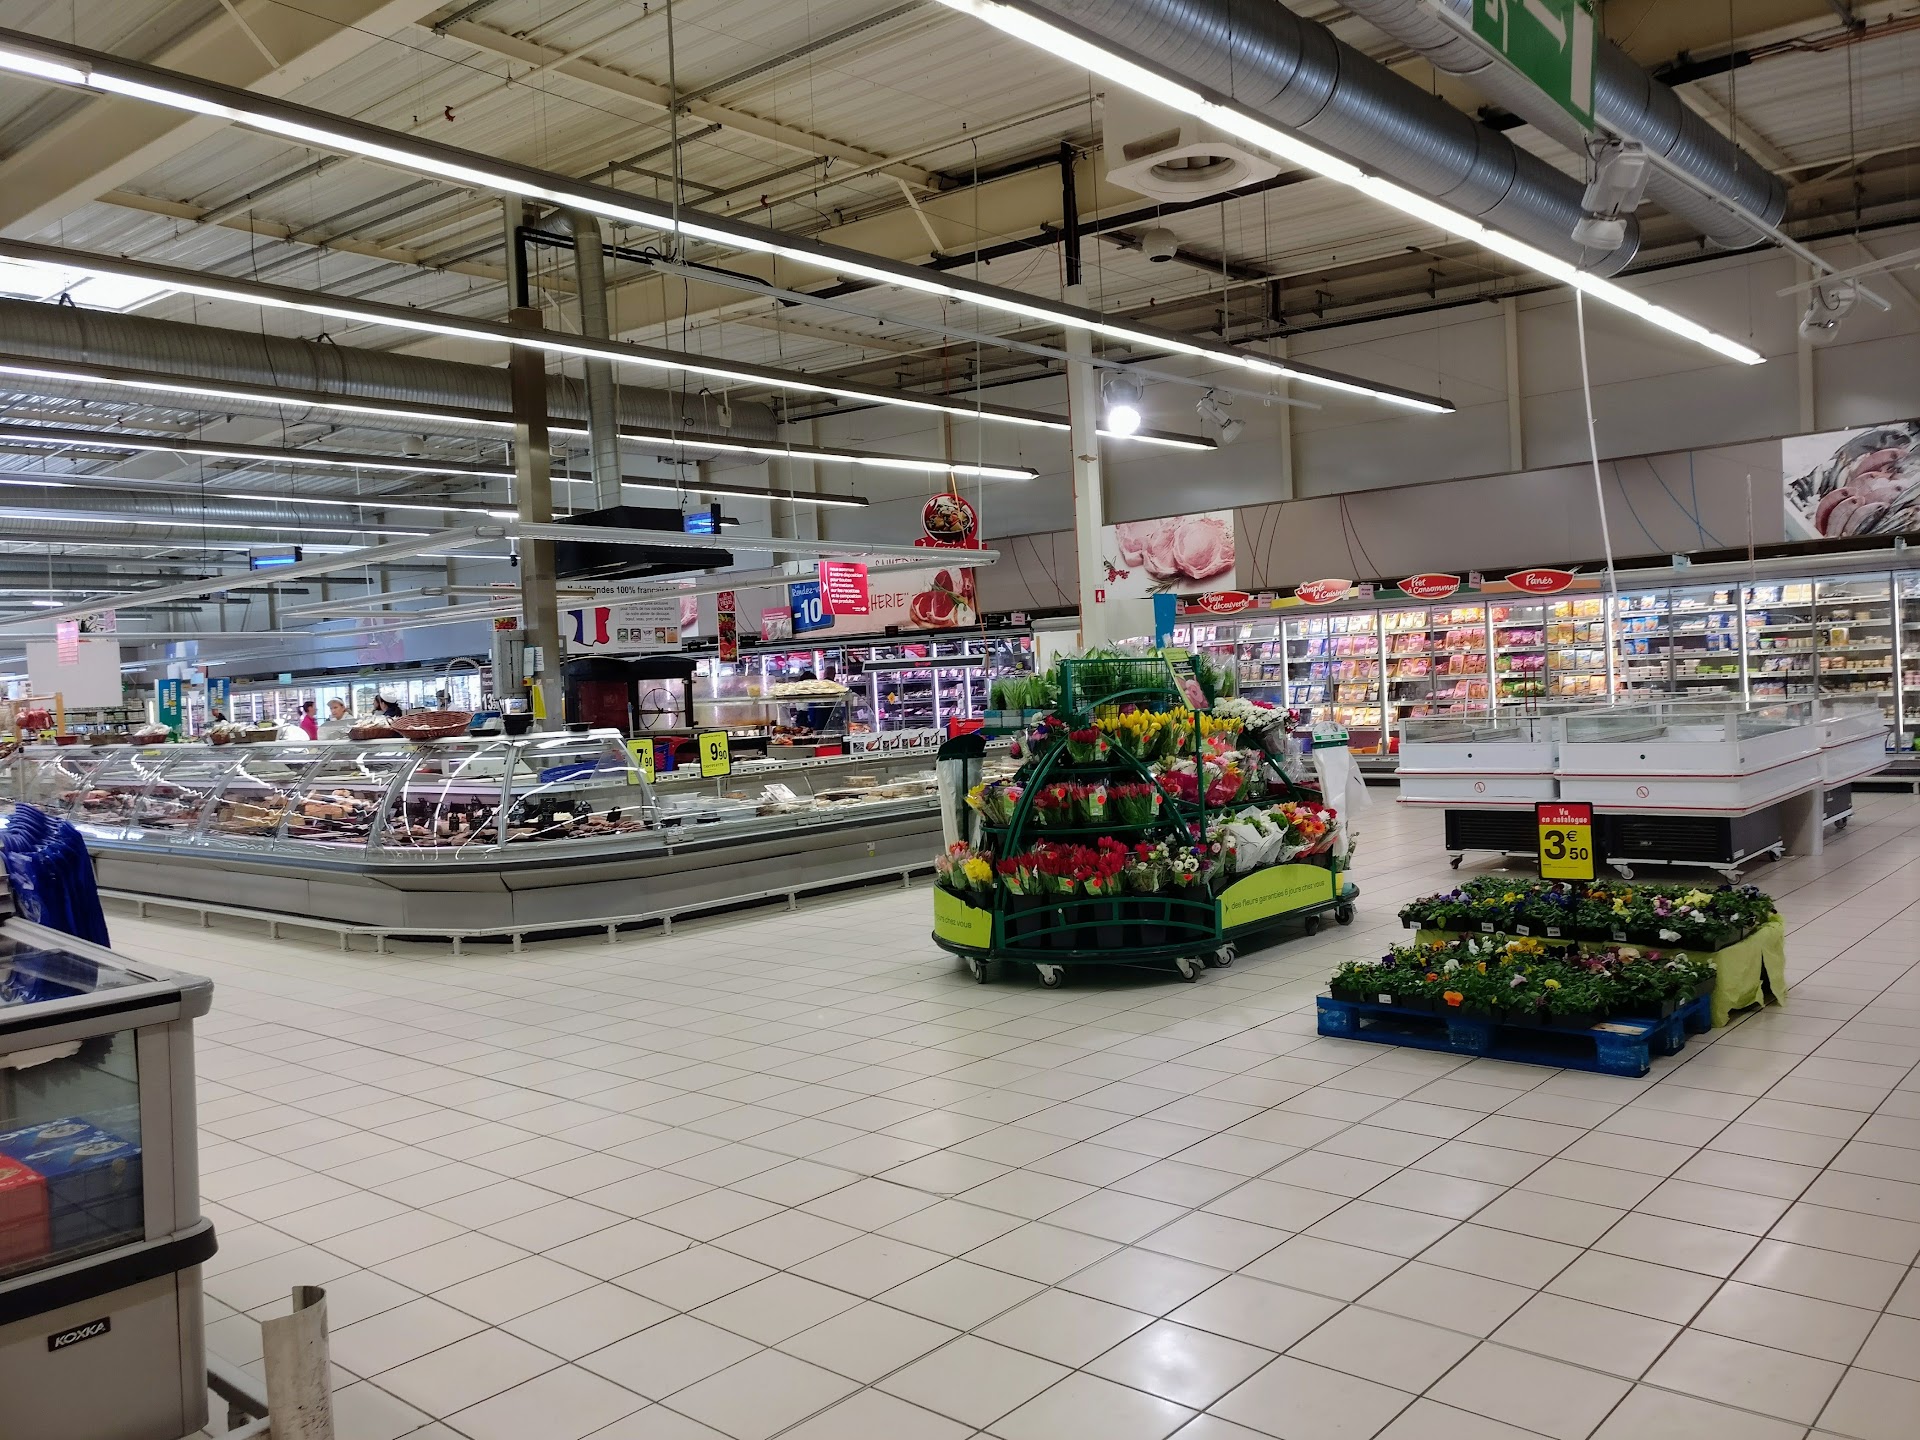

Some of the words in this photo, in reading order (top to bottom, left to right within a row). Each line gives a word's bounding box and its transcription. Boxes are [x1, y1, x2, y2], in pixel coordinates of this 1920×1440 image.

[1411, 576, 1426, 587] Prêt
[1526, 573, 1553, 586] Panés
[616, 586, 636, 594] 100%
[792, 586, 820, 597] Rendez-v
[1297, 581, 1325, 597] Simple
[794, 598, 822, 623] -10
[1553, 816, 1588, 824] catalogue
[1232, 902, 1241, 910] des
[1242, 898, 1258, 907] fleurs
[1288, 886, 1301, 897] jours
[1302, 883, 1313, 892] chez
[957, 920, 972, 928] vous
[55, 1322, 105, 1348] KOXKA
